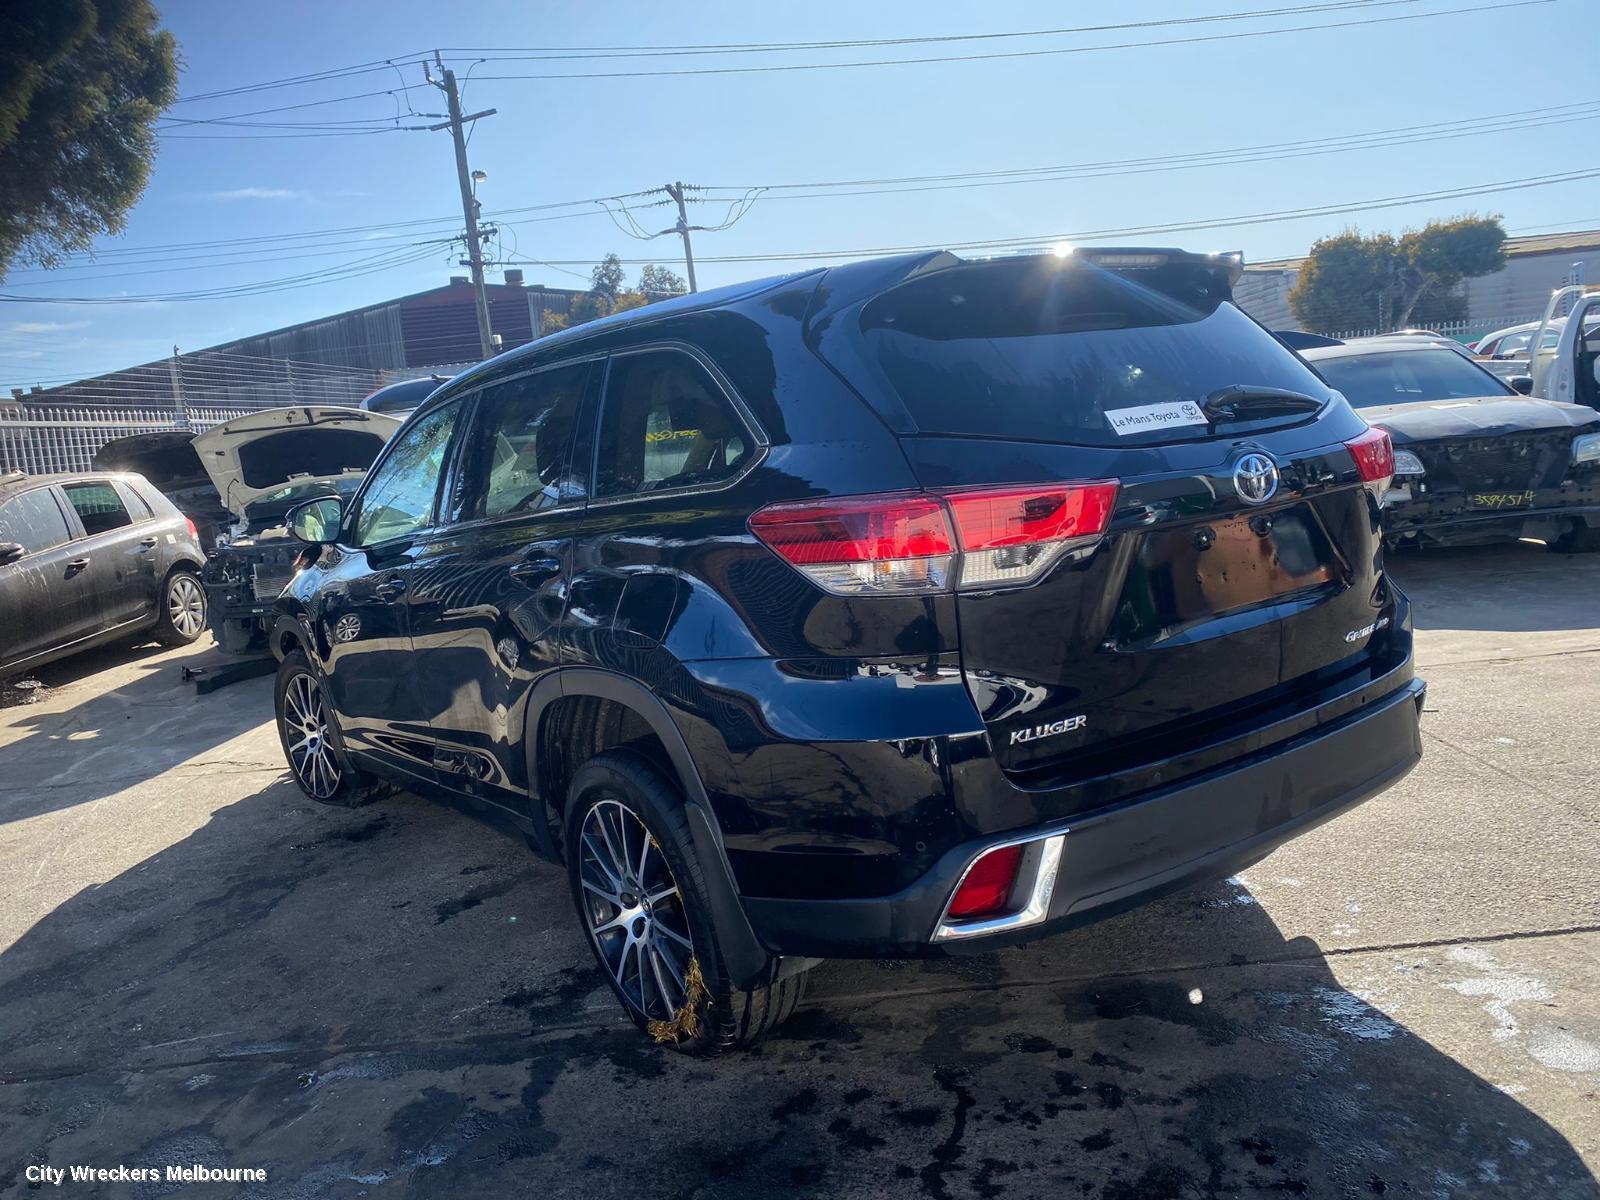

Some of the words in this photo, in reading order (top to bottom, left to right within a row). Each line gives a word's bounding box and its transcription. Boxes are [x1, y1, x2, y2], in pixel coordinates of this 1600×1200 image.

[1113, 417, 1126, 427] Le
[1125, 415, 1151, 425] Mans
[1149, 411, 1180, 423] Toyota
[1009, 714, 1088, 746] KLUGER
